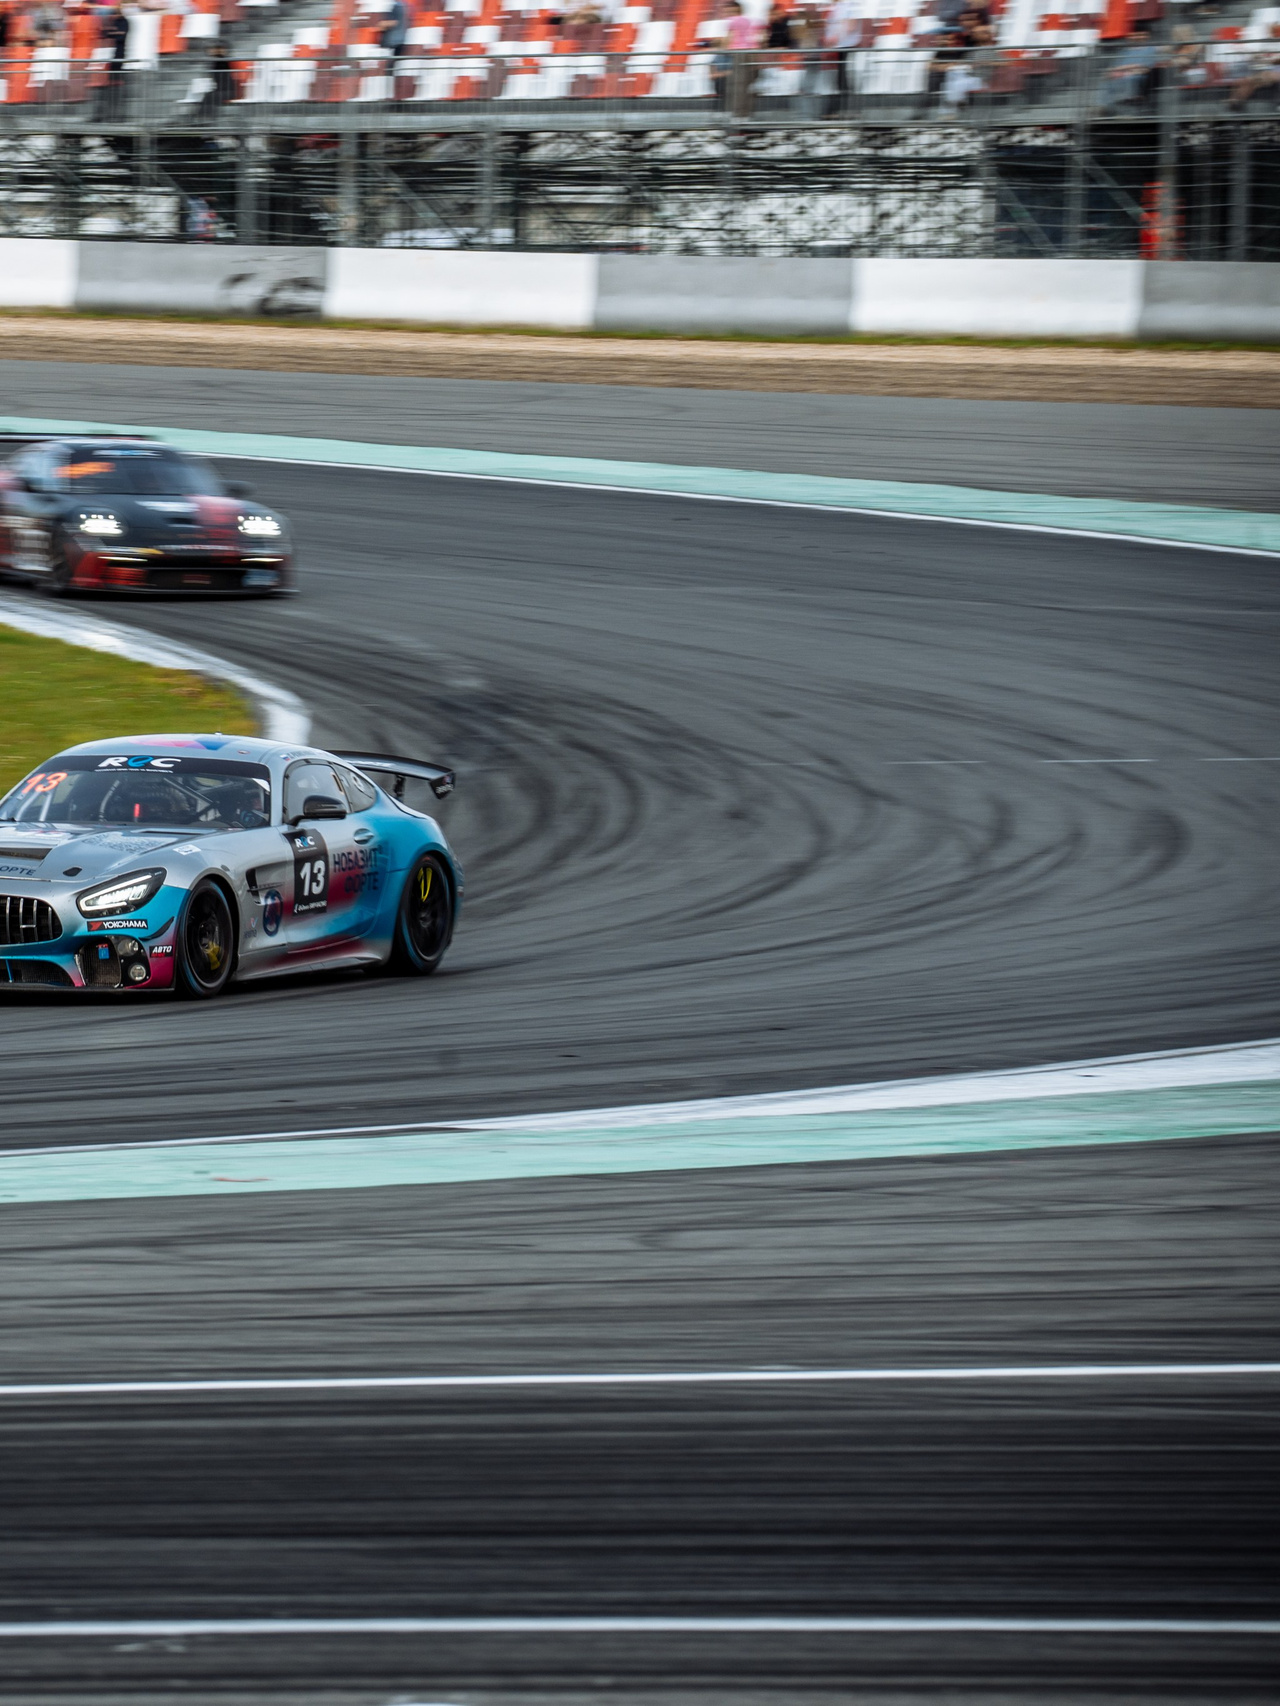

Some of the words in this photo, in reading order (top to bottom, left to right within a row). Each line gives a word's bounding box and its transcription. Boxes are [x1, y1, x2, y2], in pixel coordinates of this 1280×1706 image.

[21, 772, 68, 794] 13
[300, 860, 326, 896] 13
[344, 872, 379, 893] ФОРТЕ
[103, 920, 147, 929] YOKOHAMA
